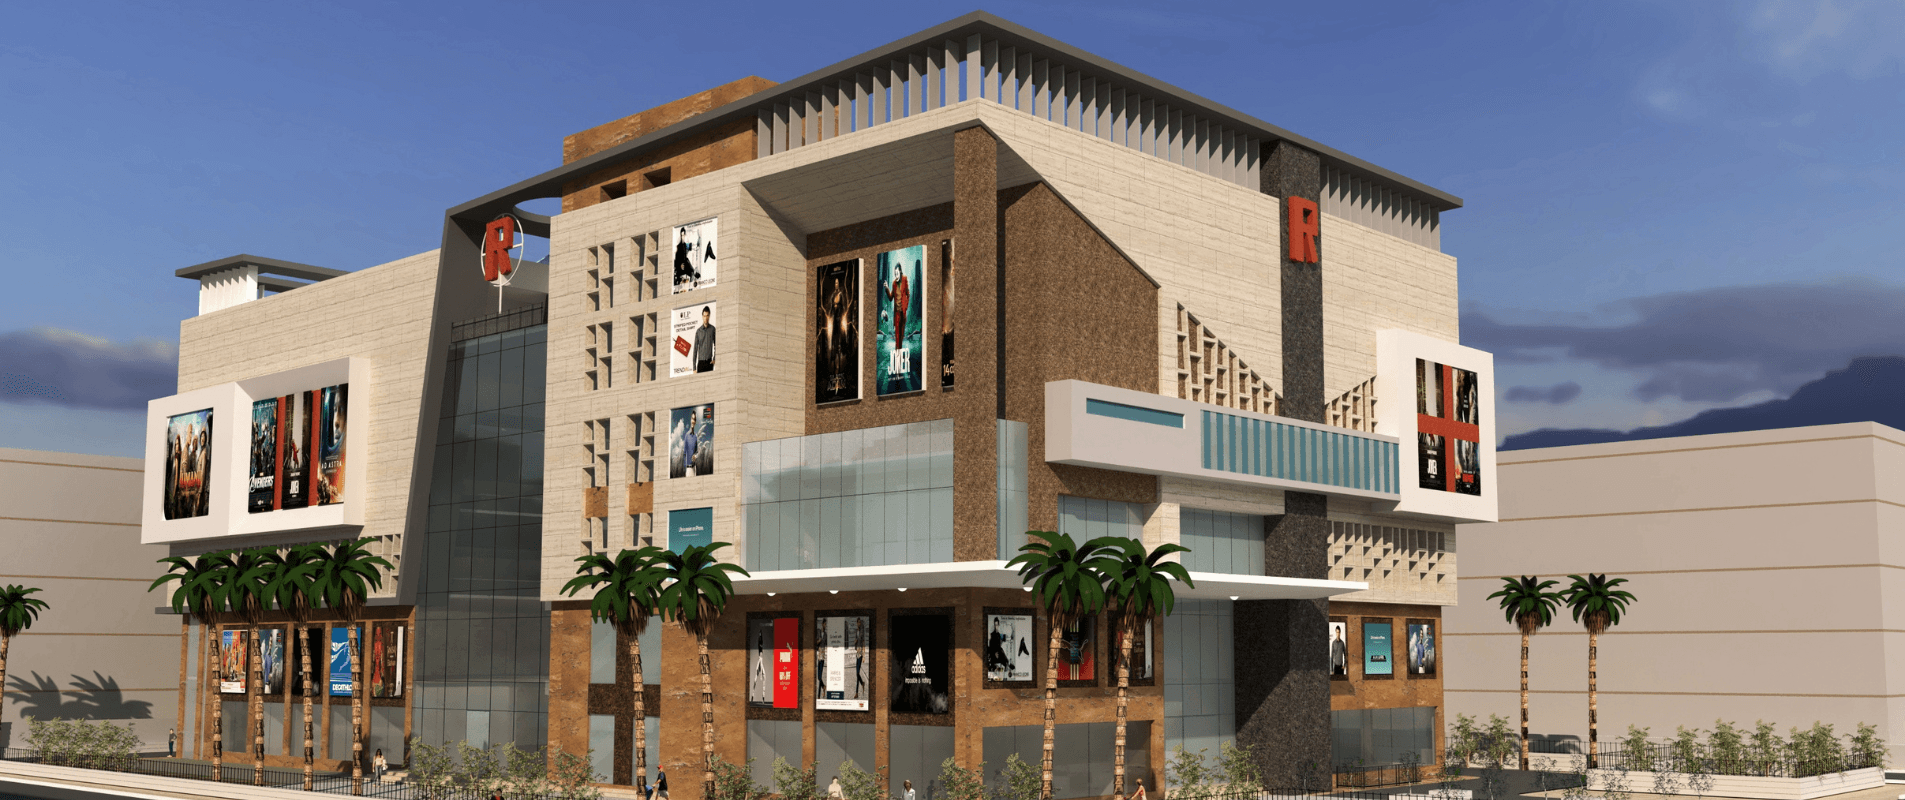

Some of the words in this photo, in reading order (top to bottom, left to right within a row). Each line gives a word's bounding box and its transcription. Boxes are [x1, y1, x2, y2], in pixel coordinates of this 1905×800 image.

[485, 216, 514, 281] R
[1288, 196, 1318, 263] R
[888, 348, 910, 375] JOKER
[911, 664, 926, 674] adidas
